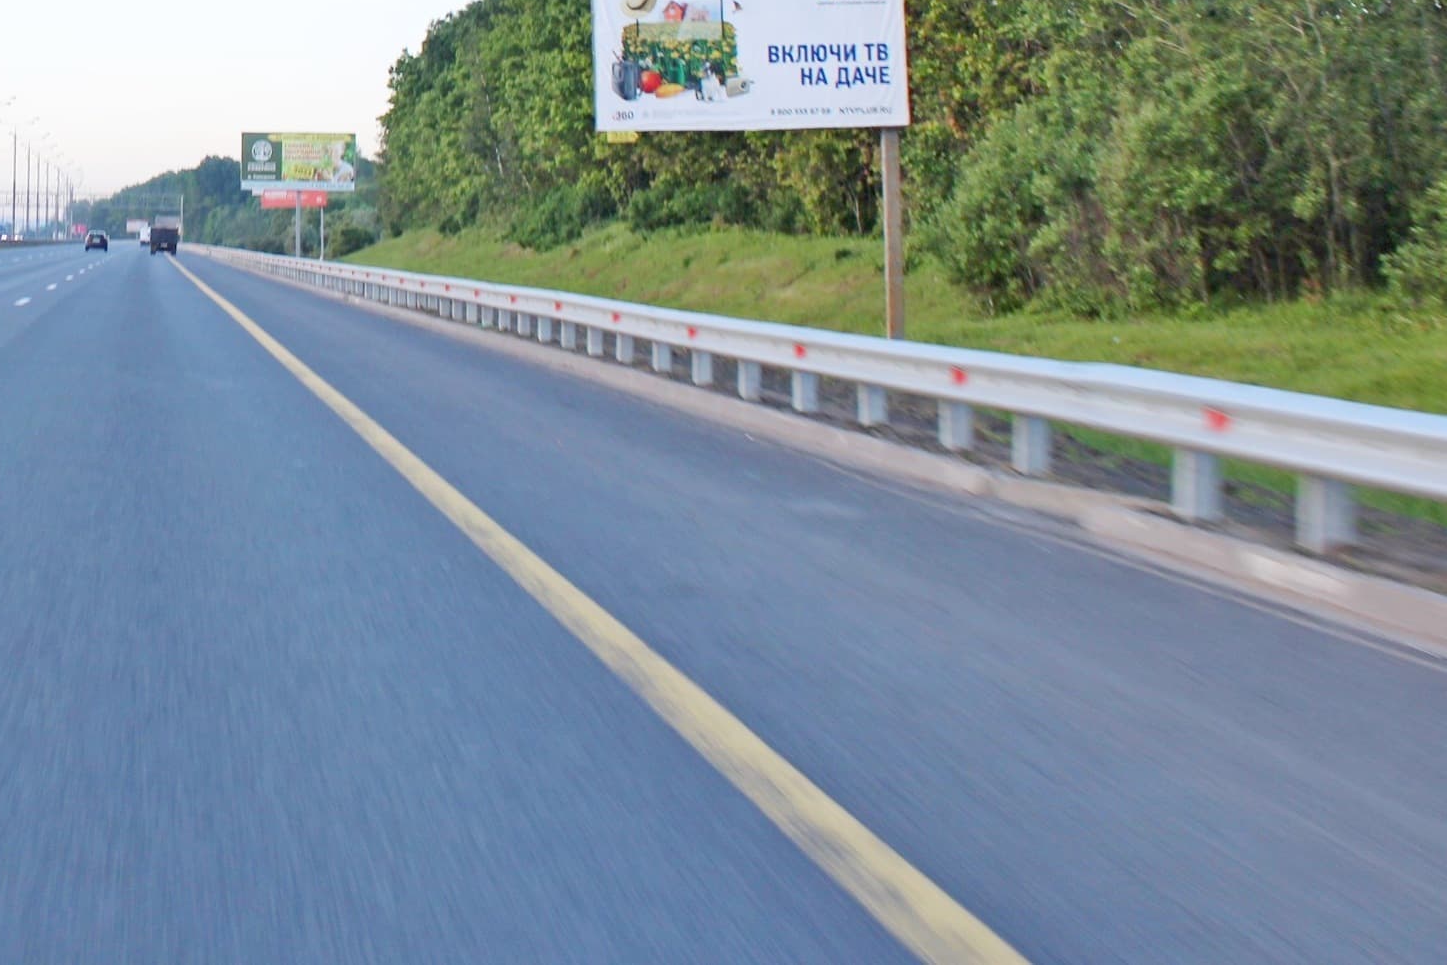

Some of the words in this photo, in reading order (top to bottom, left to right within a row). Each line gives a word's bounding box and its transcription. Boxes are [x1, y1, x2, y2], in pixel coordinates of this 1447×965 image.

[768, 44, 856, 63] ВКЛЮЧИ
[864, 43, 889, 61] ТВ
[801, 67, 828, 85] НА
[835, 66, 891, 88] ДАЧЕ
